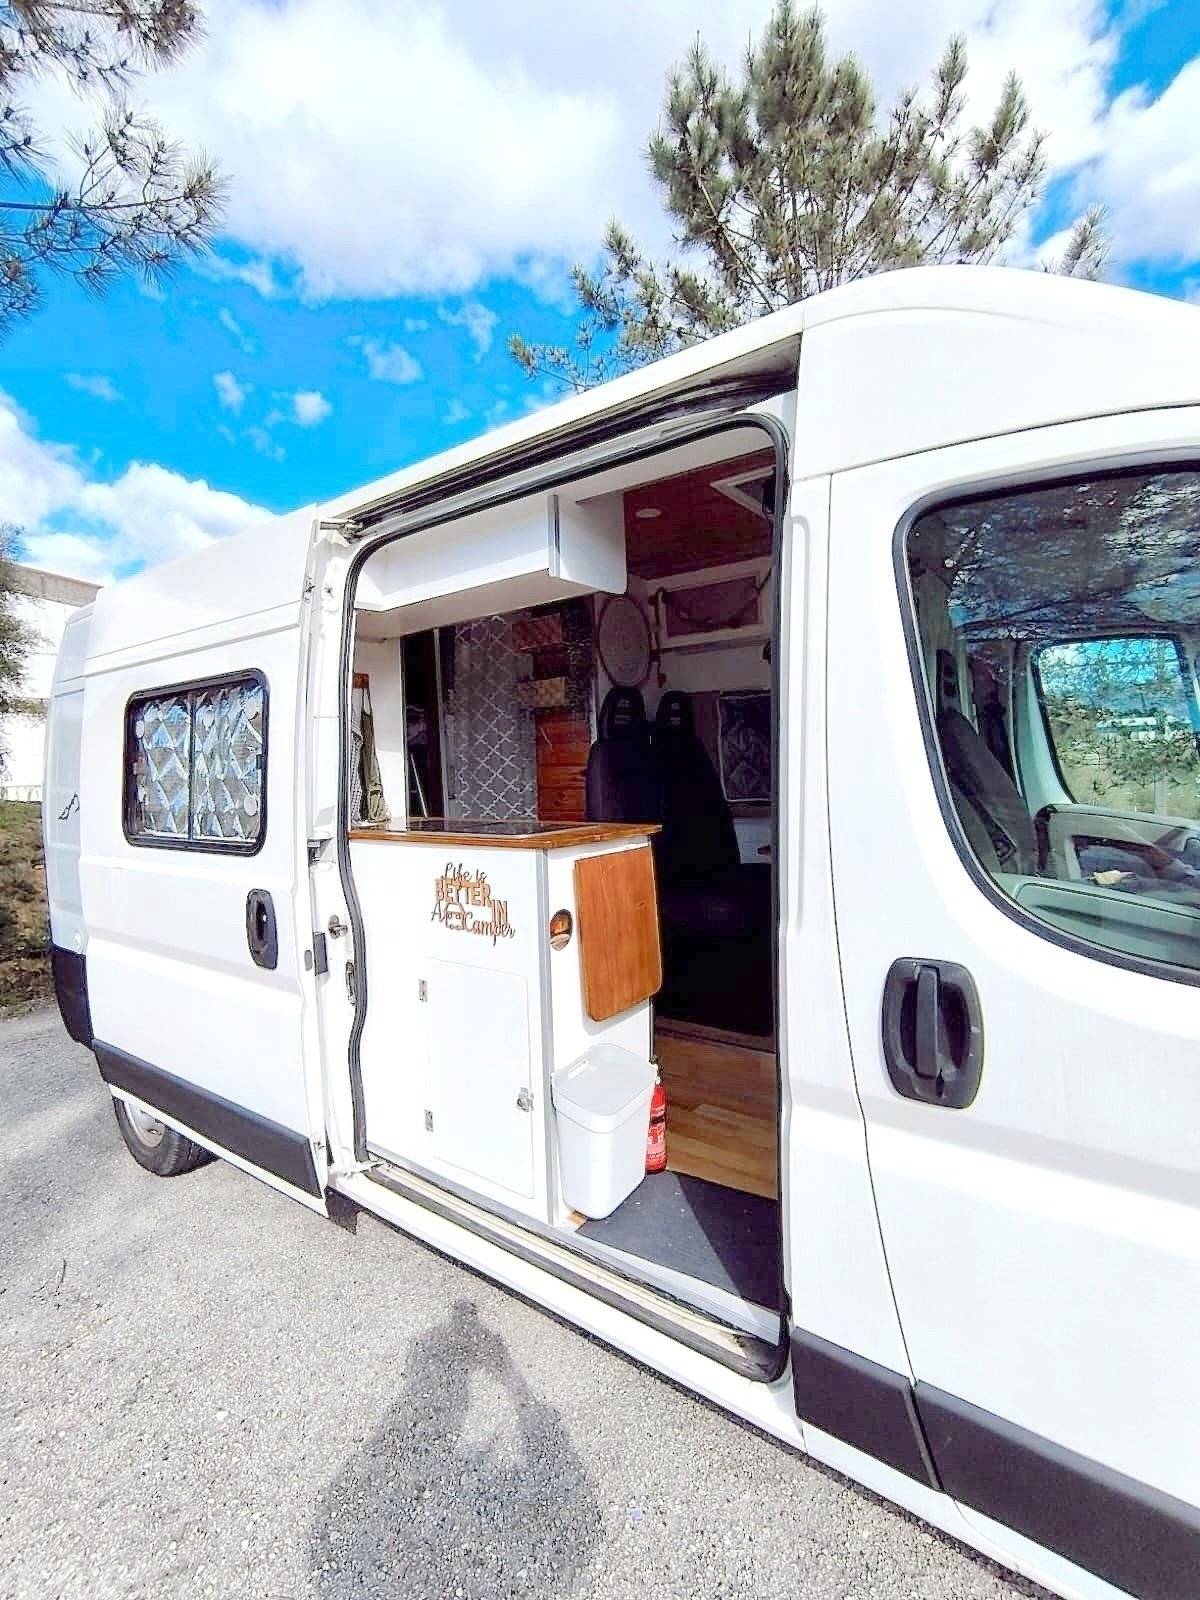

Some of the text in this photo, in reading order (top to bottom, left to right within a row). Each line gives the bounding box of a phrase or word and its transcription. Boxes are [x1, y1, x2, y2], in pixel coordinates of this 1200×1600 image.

[441, 861, 472, 889] Life
[434, 877, 493, 908] BETTER
[491, 899, 508, 927] IN
[464, 911, 516, 946] Camper
